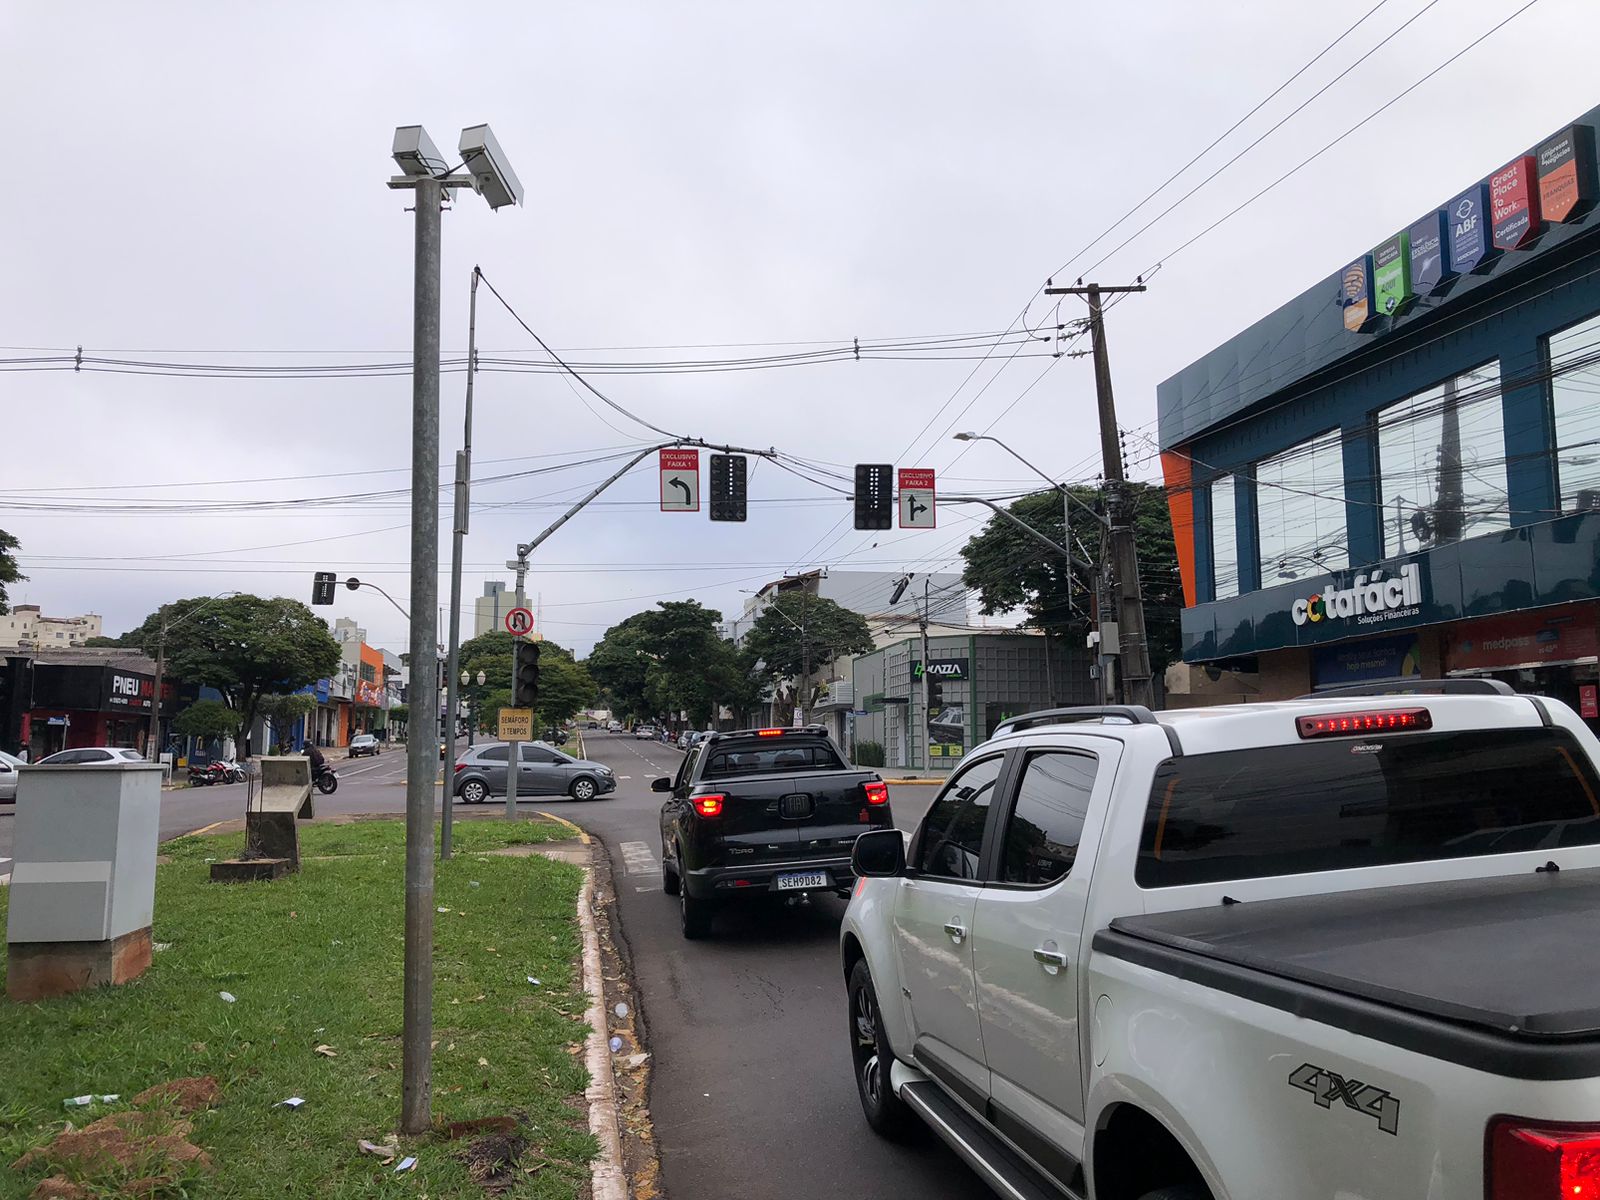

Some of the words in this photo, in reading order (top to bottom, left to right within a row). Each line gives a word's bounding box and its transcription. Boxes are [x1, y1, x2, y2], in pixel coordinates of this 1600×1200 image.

[1492, 167, 1517, 187] Great
[1493, 179, 1518, 198] Place
[1494, 198, 1504, 209] To
[1494, 200, 1520, 221] Work.
[1456, 215, 1478, 238] ABF
[1494, 215, 1529, 239] Certificada
[1357, 612, 1384, 626] Soluções
[1384, 606, 1420, 621] Financeiras
[1482, 636, 1531, 652] medpass
[113, 675, 139, 696] PNEU
[501, 715, 529, 723] SEMÁFORO
[789, 796, 808, 811] FIAT
[781, 875, 822, 889] SEH9D82
